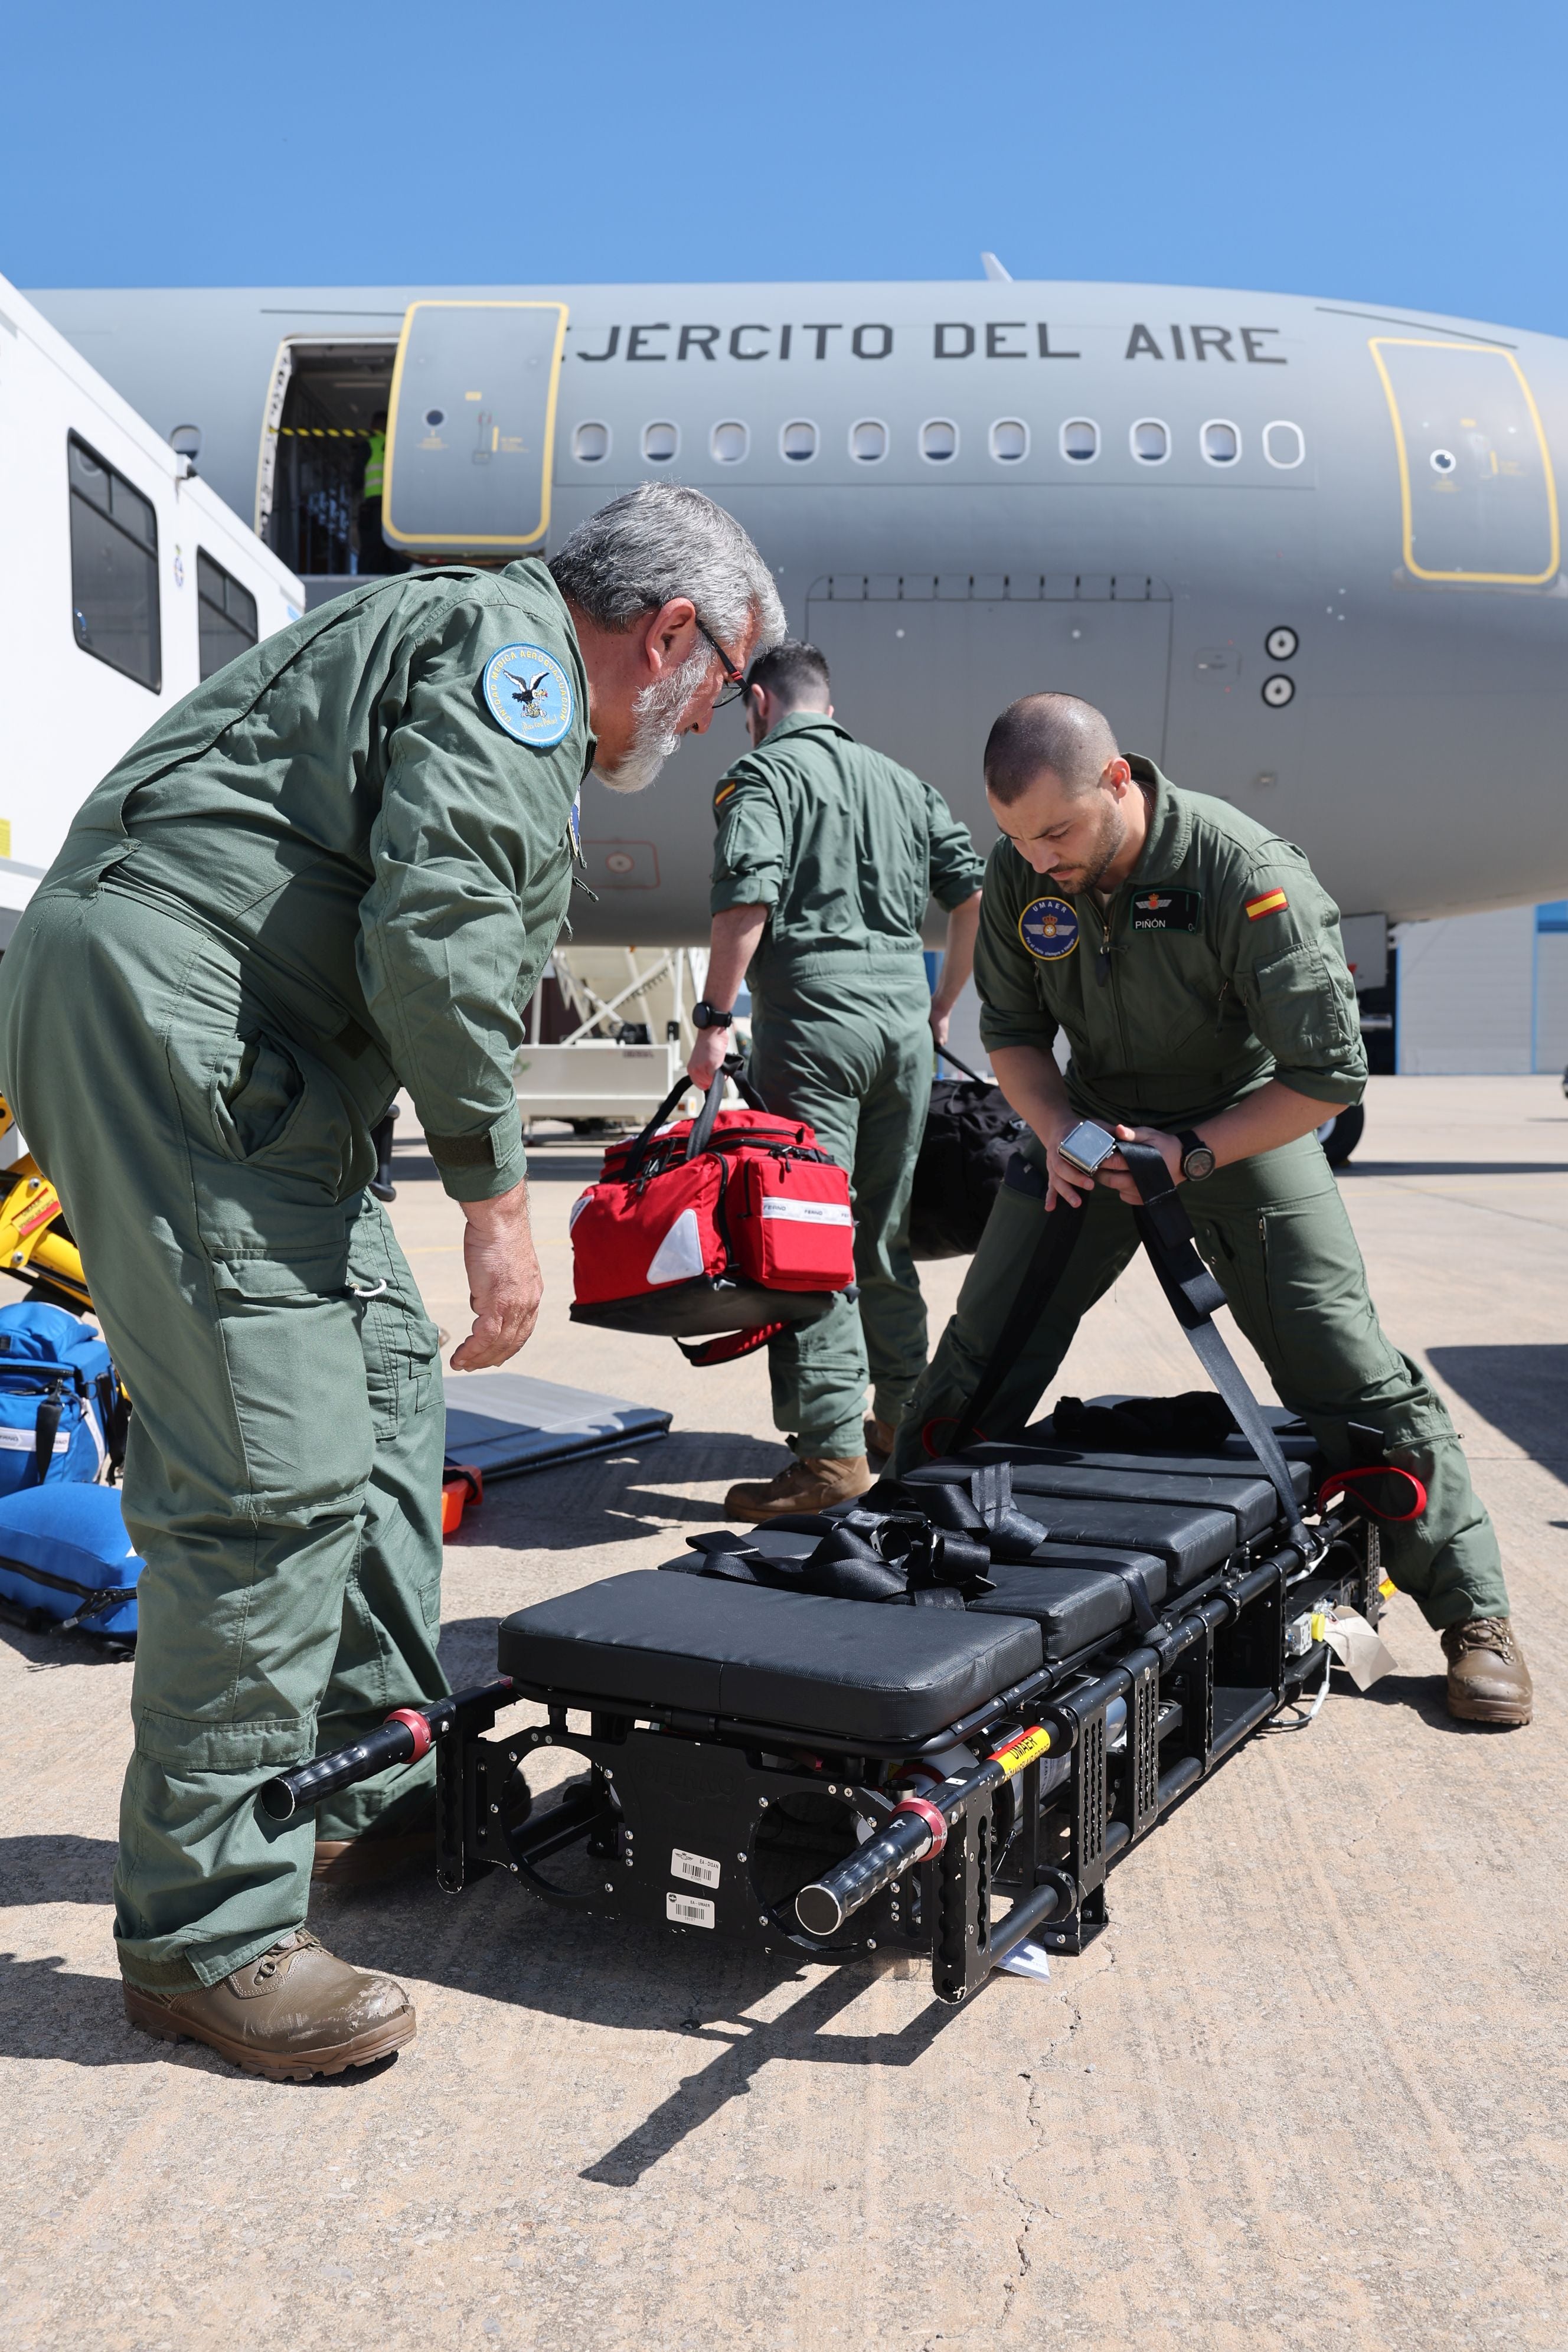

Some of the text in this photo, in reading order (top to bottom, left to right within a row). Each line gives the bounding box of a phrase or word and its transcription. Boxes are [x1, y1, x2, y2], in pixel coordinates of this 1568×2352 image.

[562, 322, 1288, 364] JÉRCITO DEL AIRE
[491, 651, 568, 723] UNIDAD MEDICA AEROEVACUACION
[1033, 901, 1067, 913] UMAER
[1135, 918, 1166, 929] PIÑÓN
[1007, 1736, 1038, 1760] UMAER
